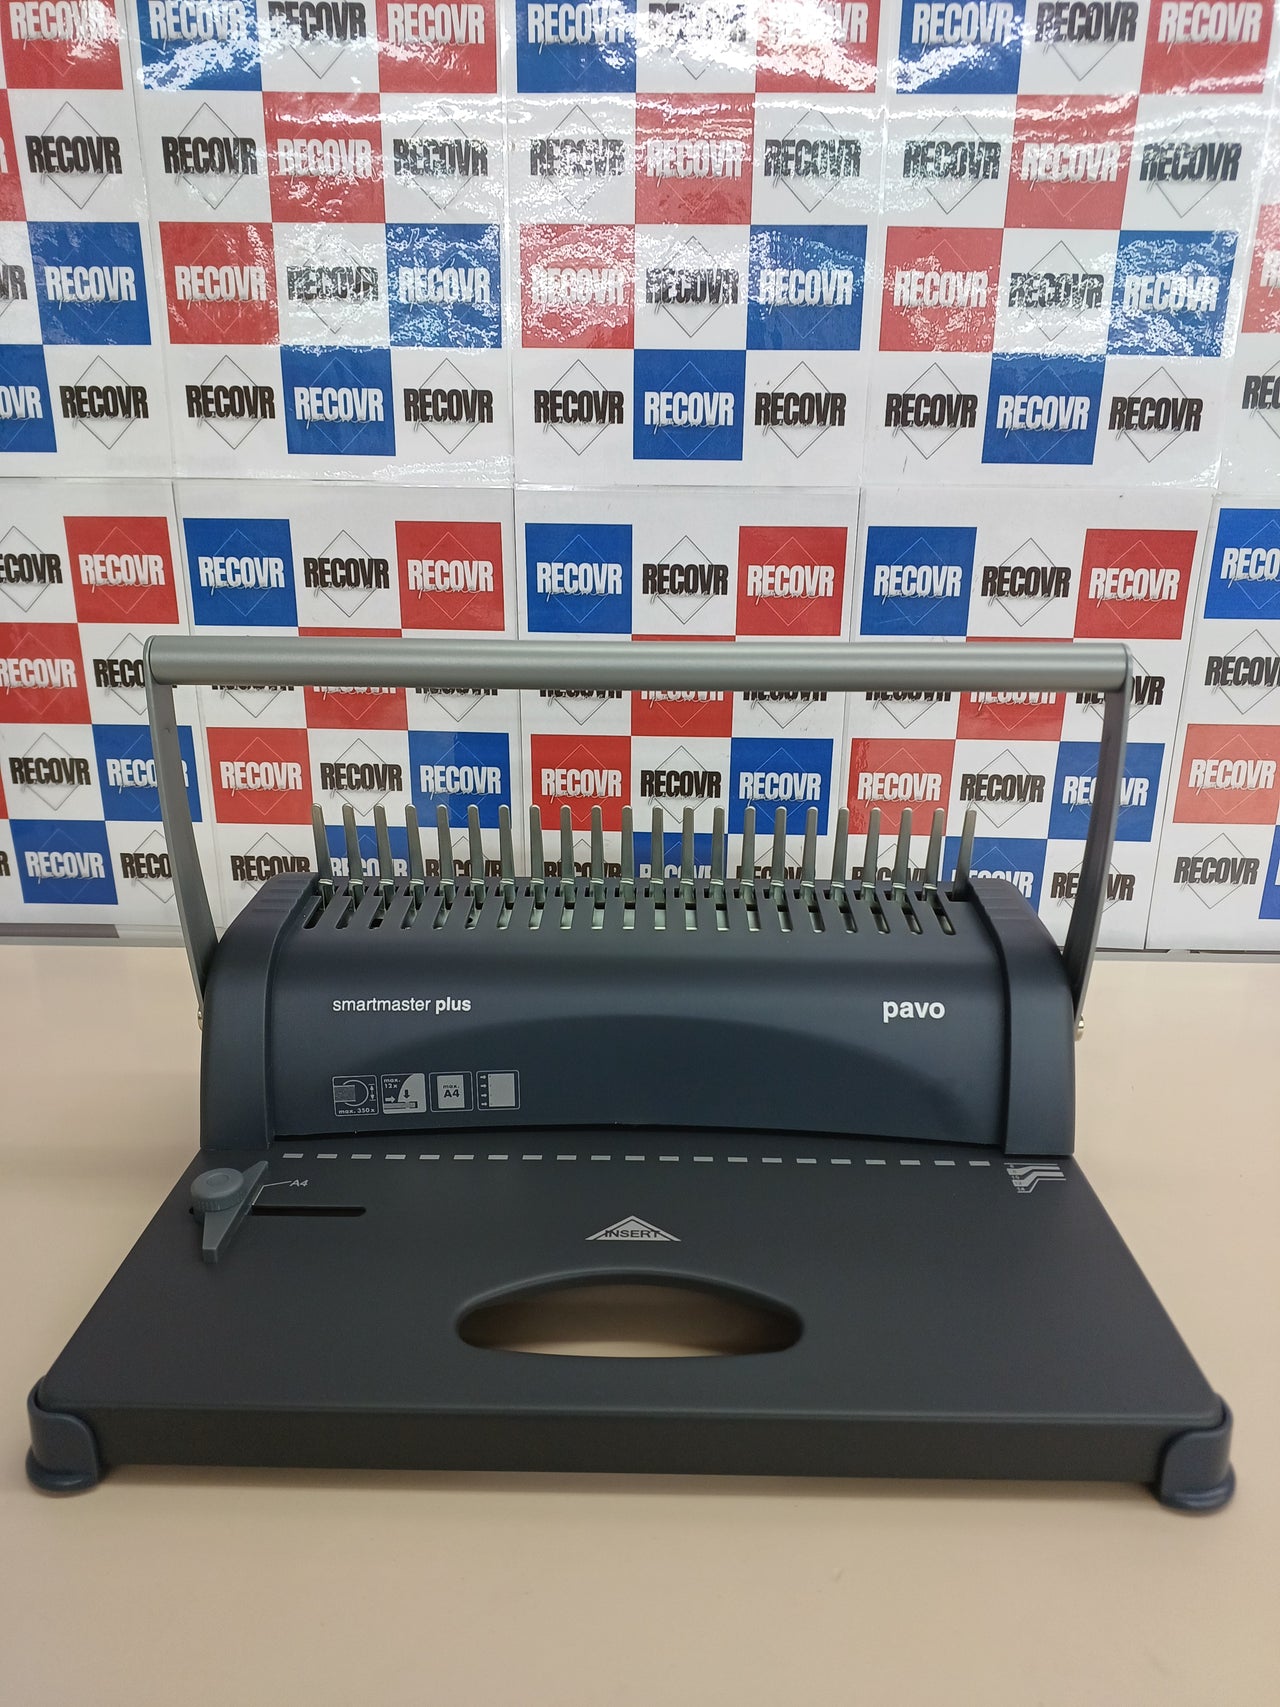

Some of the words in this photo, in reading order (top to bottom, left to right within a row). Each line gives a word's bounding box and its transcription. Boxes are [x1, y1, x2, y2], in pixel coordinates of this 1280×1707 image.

[388, 3, 486, 43] RECOVR
[911, 2, 1014, 44] RECOVR
[1034, 1, 1139, 42] RECOVR
[1157, 2, 1262, 43] RECOVR
[25, 136, 122, 174] RECOVR
[161, 136, 258, 174] RECOVR
[277, 139, 372, 177] RECOVR
[764, 139, 861, 177] RECOVR
[903, 141, 1001, 179] RECOVR
[1139, 142, 1241, 181] RECOVR
[45, 266, 136, 301] RECOVR
[175, 266, 268, 301] RECOVR
[758, 270, 854, 305] RECOVR
[894, 271, 988, 307] RECOVR
[60, 386, 149, 419] RECOVR
[185, 385, 275, 419] RECOVR
[294, 387, 384, 421] RECOVR
[403, 389, 493, 423] RECOVR
[534, 390, 624, 424] RECOVR
[644, 391, 734, 426] RECOVR
[754, 392, 847, 426] RECOVR
[885, 393, 978, 428] RECOVR
[996, 396, 1090, 431] RECOVR
[1108, 397, 1203, 432] RECOVR
[78, 554, 165, 586] RECOVR
[198, 556, 285, 588] RECOVR
[303, 558, 390, 589] RECOVR
[408, 559, 494, 592] RECOVR
[537, 561, 623, 595] RECOVR
[642, 564, 728, 596] RECOVR
[747, 565, 835, 597] RECOVR
[874, 565, 963, 597] RECOVR
[981, 566, 1072, 598] RECOVR
[1088, 568, 1181, 601] RECOVR
[9, 757, 91, 785] RECOVR
[219, 761, 303, 790] RECOVR
[320, 762, 402, 792] RECOVR
[420, 764, 501, 795] RECOVR
[541, 768, 622, 797] RECOVR
[640, 769, 722, 799] RECOVR
[739, 771, 822, 801] RECOVR
[857, 772, 943, 801] RECOVR
[1188, 758, 1277, 789] RECOVR
[959, 773, 1046, 803] RECOVR
[24, 851, 106, 879] RECOVR
[1174, 857, 1260, 885] RECOVR
[333, 997, 431, 1012] smartmaster
[435, 996, 472, 1015] plus
[882, 1000, 946, 1024] pavo
[443, 1089, 460, 1098] A4
[289, 1179, 309, 1187] A4
[604, 1229, 661, 1239] INSERT
